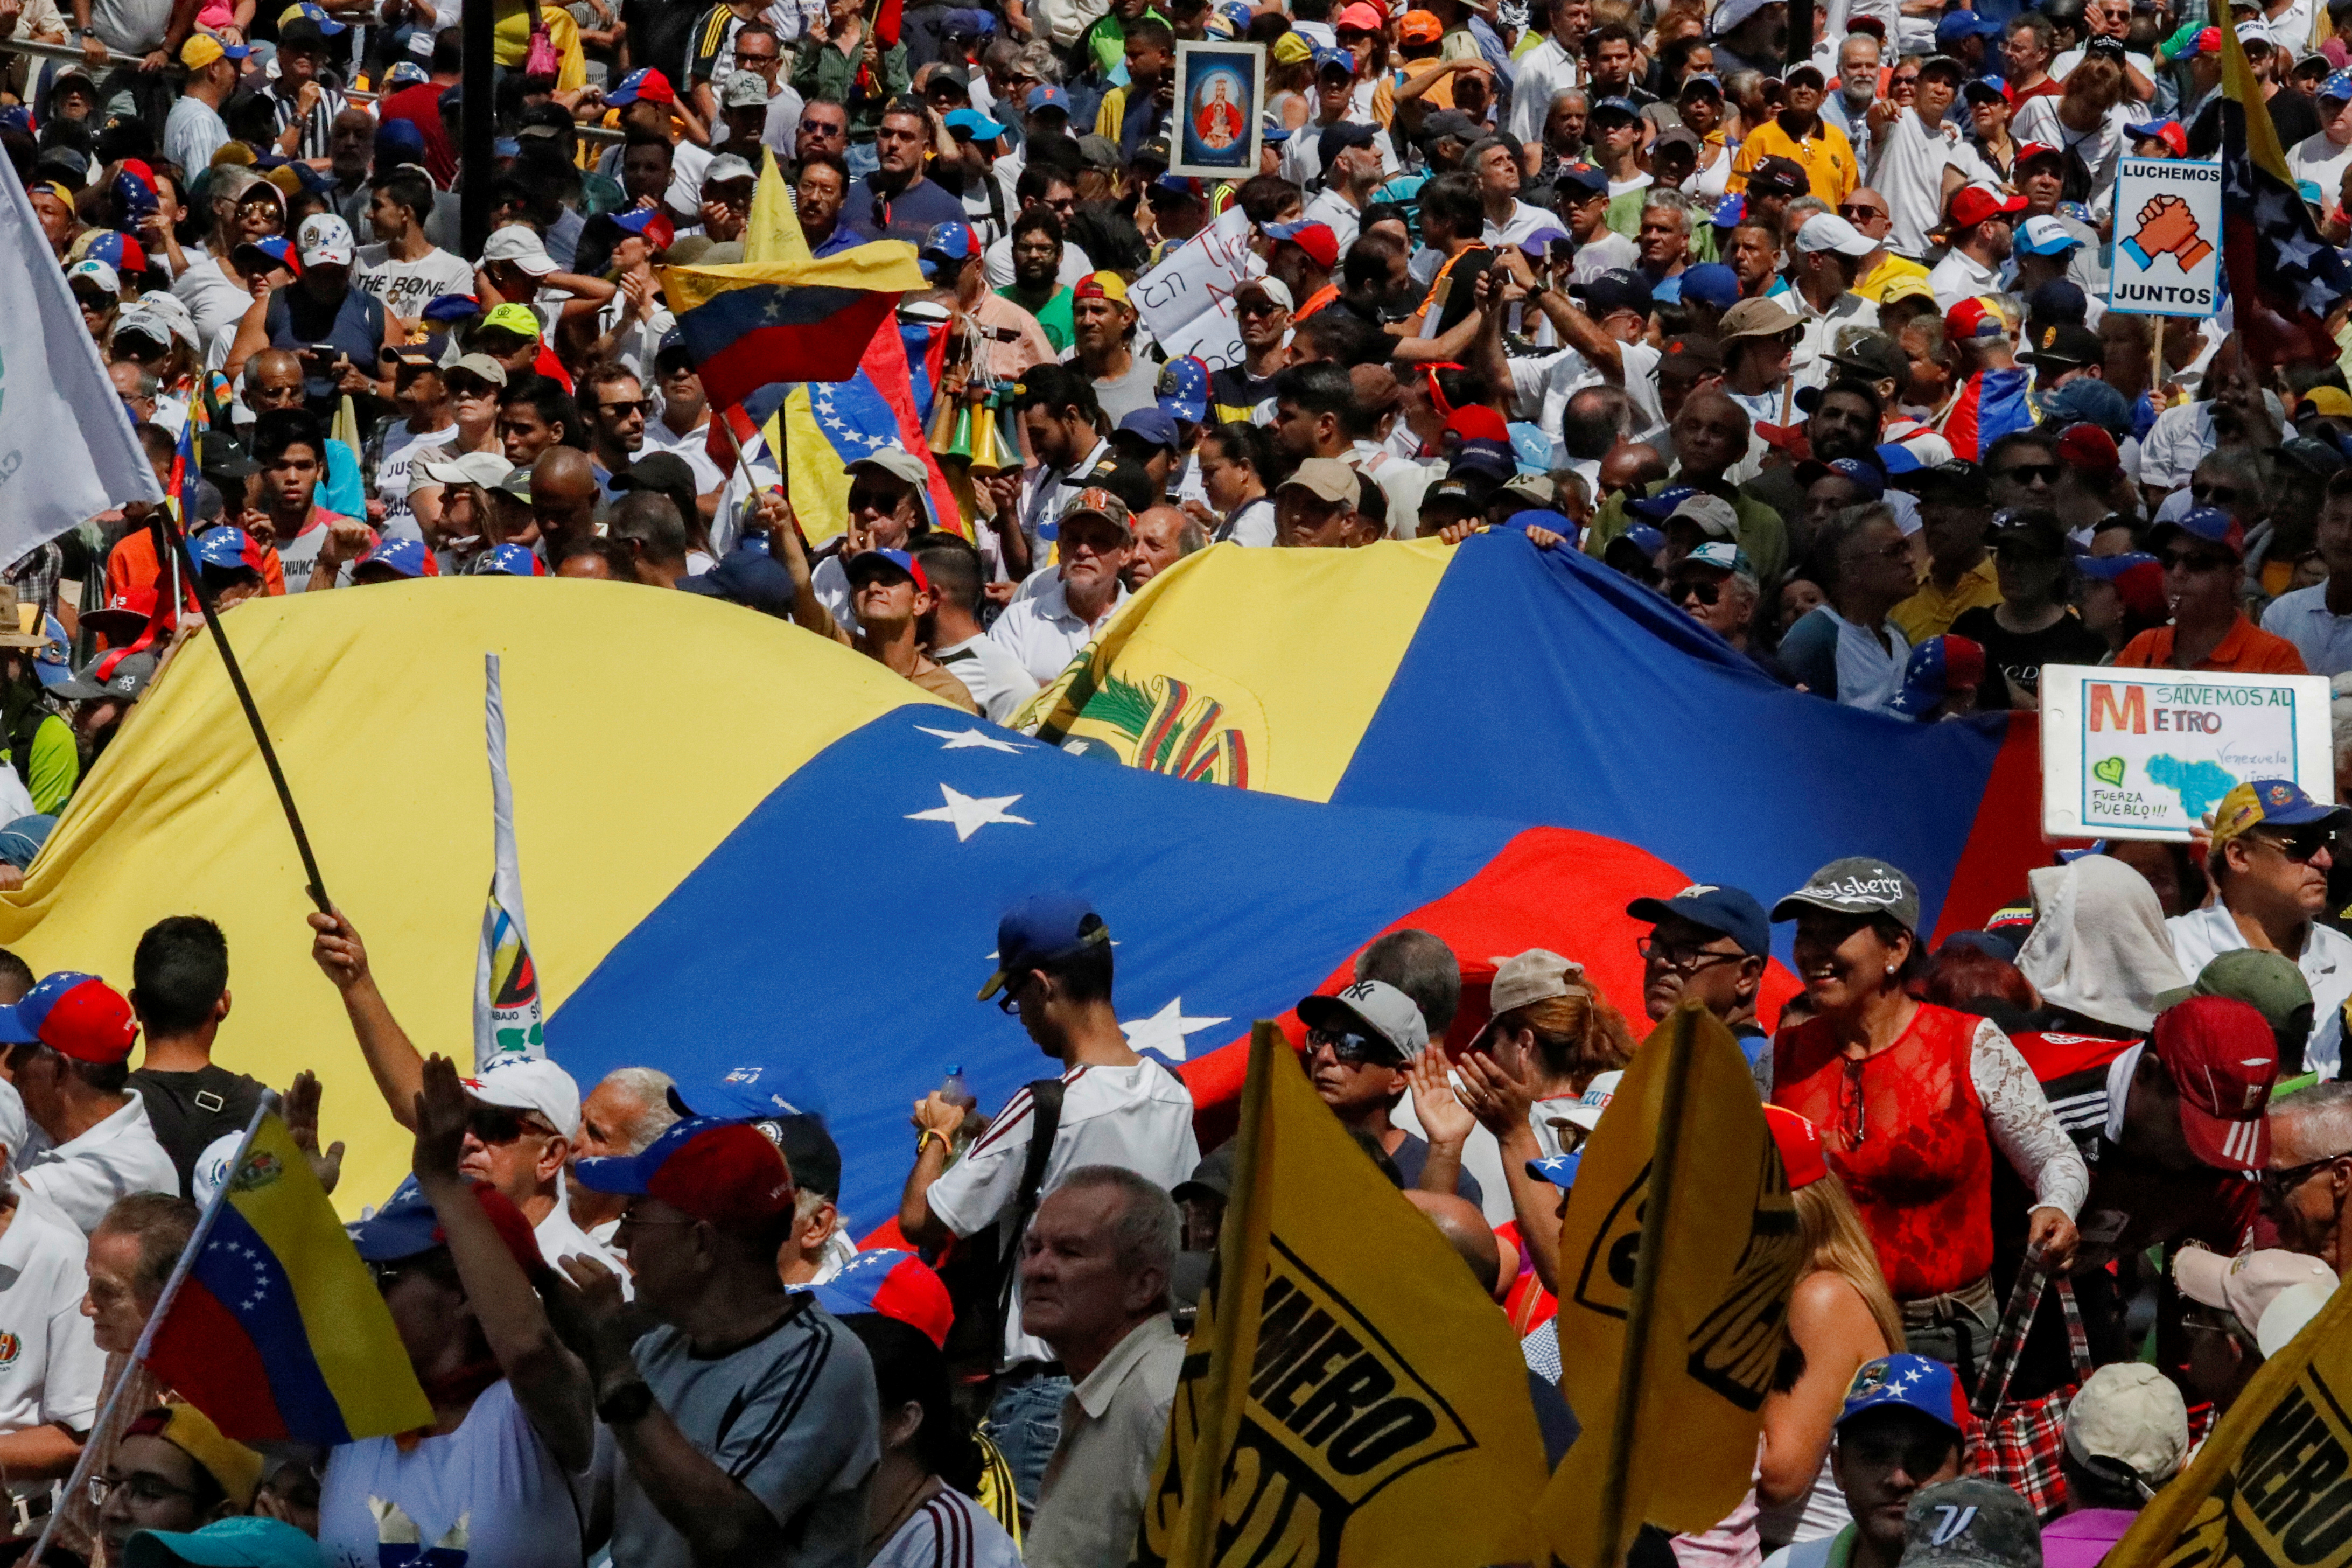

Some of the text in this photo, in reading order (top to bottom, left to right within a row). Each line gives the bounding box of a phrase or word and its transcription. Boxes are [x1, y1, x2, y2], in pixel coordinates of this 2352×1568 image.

[2123, 164, 2221, 181] LUCHEMOS
[358, 274, 445, 297] THE BONE
[2115, 284, 2211, 304] JUNTOS
[2157, 688, 2290, 706] SALVEMOS AL
[2217, 741, 2287, 764] Venezuela
[2092, 789, 2143, 802] FUERZA
[1796, 876, 1903, 899] Carlsberg
[1345, 982, 1375, 1001] NY
